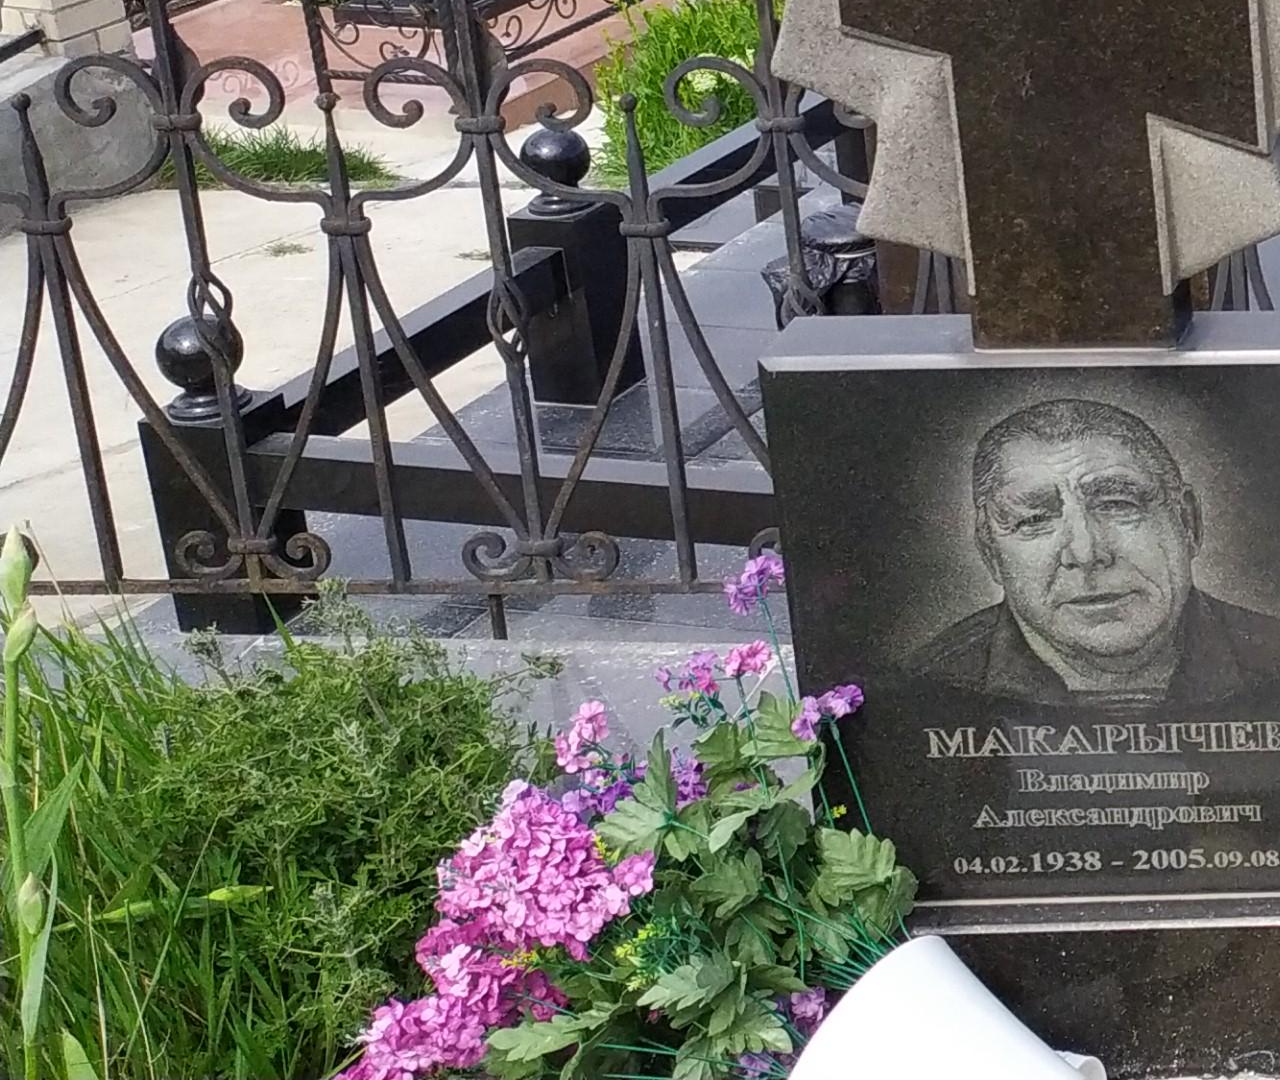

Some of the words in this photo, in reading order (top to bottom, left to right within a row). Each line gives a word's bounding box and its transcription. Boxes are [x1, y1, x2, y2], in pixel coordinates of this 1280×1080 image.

[1017, 768, 1210, 796] Владимир
[973, 804, 1263, 830] Александрович
[953, 850, 1102, 874] 04.02.1938
